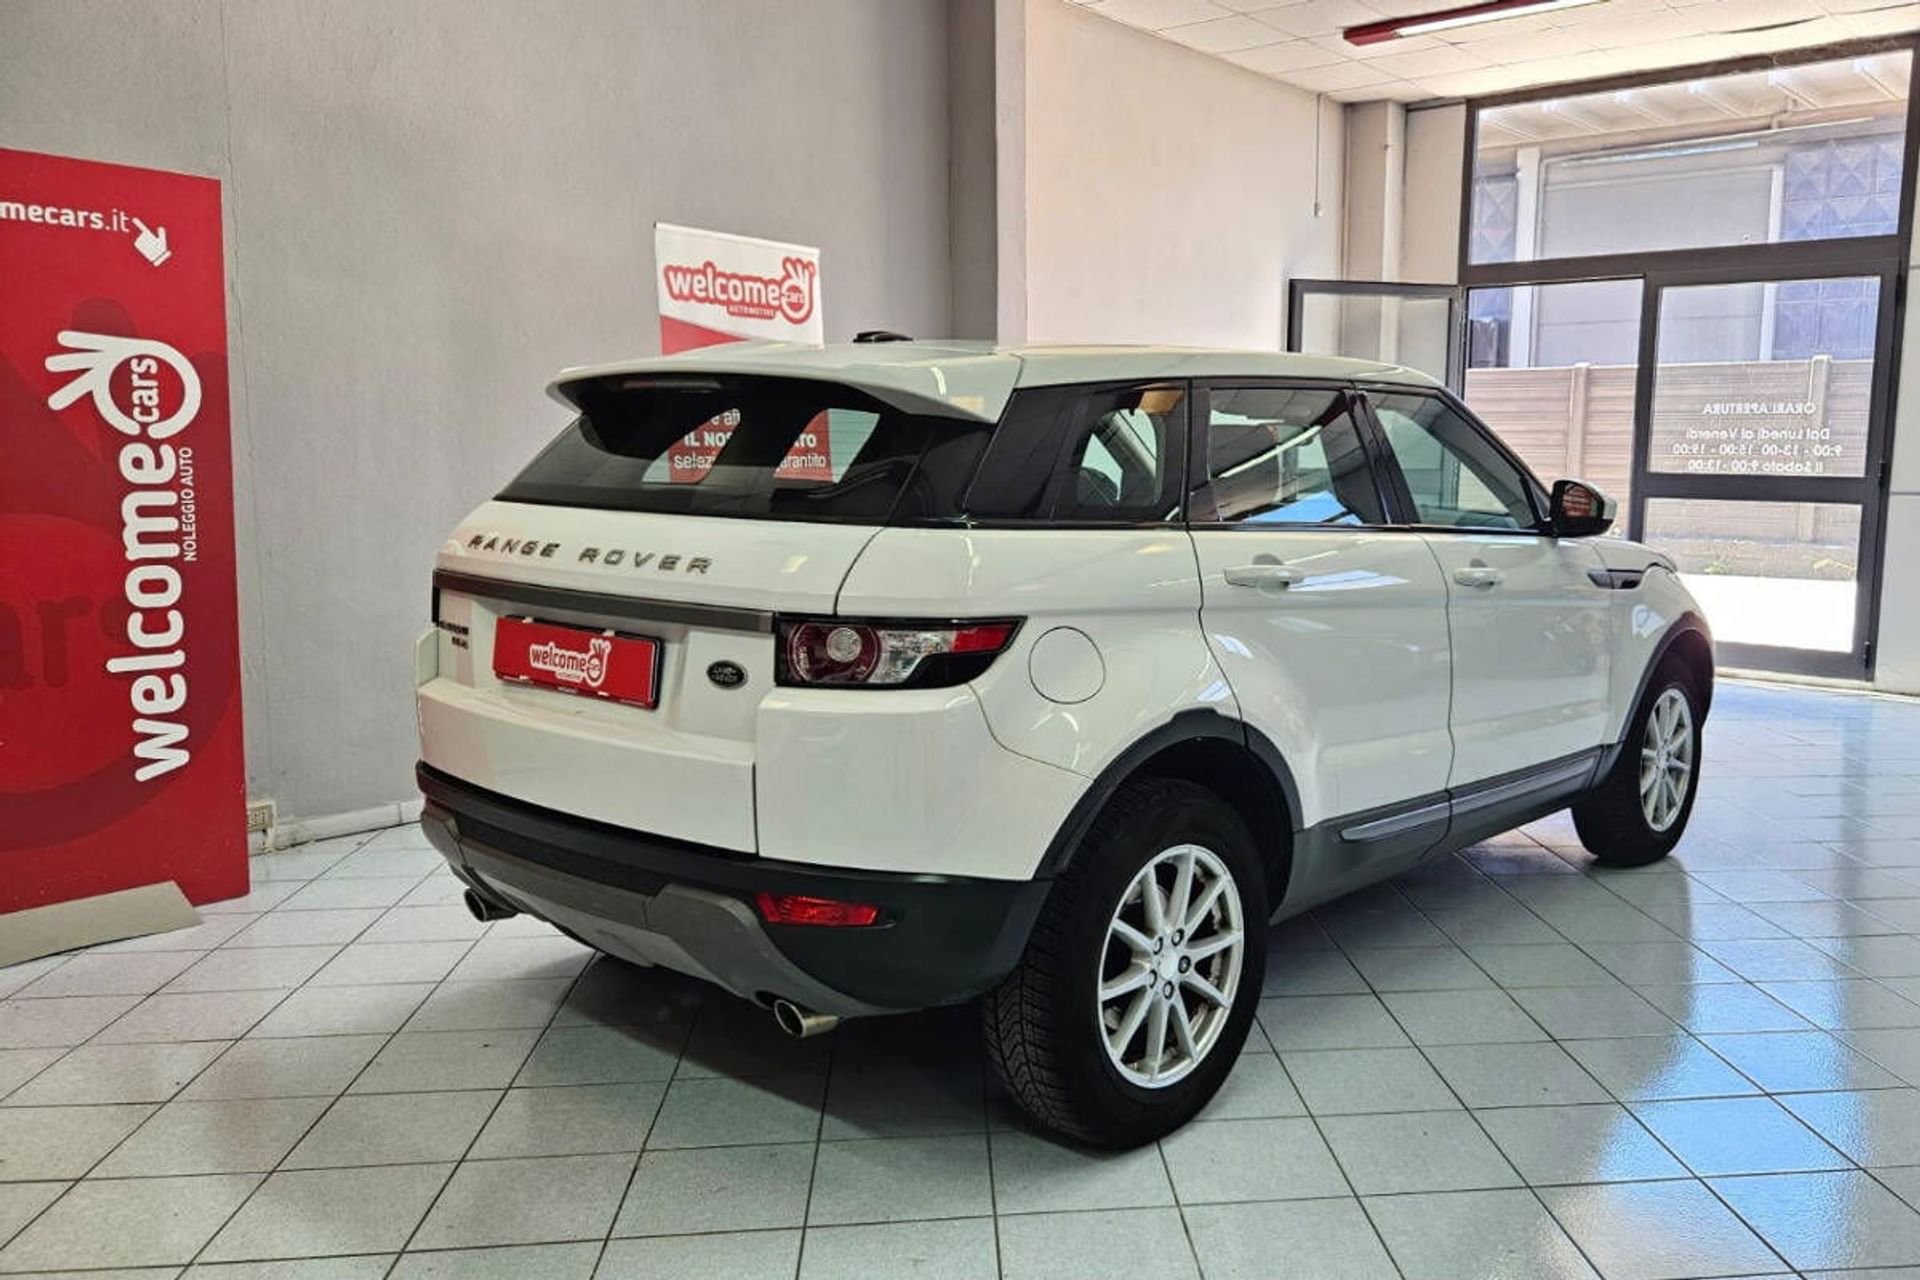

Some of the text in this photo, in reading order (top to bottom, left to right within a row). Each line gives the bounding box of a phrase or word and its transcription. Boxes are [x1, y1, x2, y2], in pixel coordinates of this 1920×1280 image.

[0, 201, 130, 233] mecars.it
[668, 266, 780, 306] welcome
[130, 357, 160, 424] cars
[793, 433, 817, 448] TO
[179, 447, 197, 561] NOLEGGIO AUTO
[466, 534, 714, 574] RANGE ROVER
[106, 442, 190, 782] welcome
[531, 647, 587, 673] welcome
